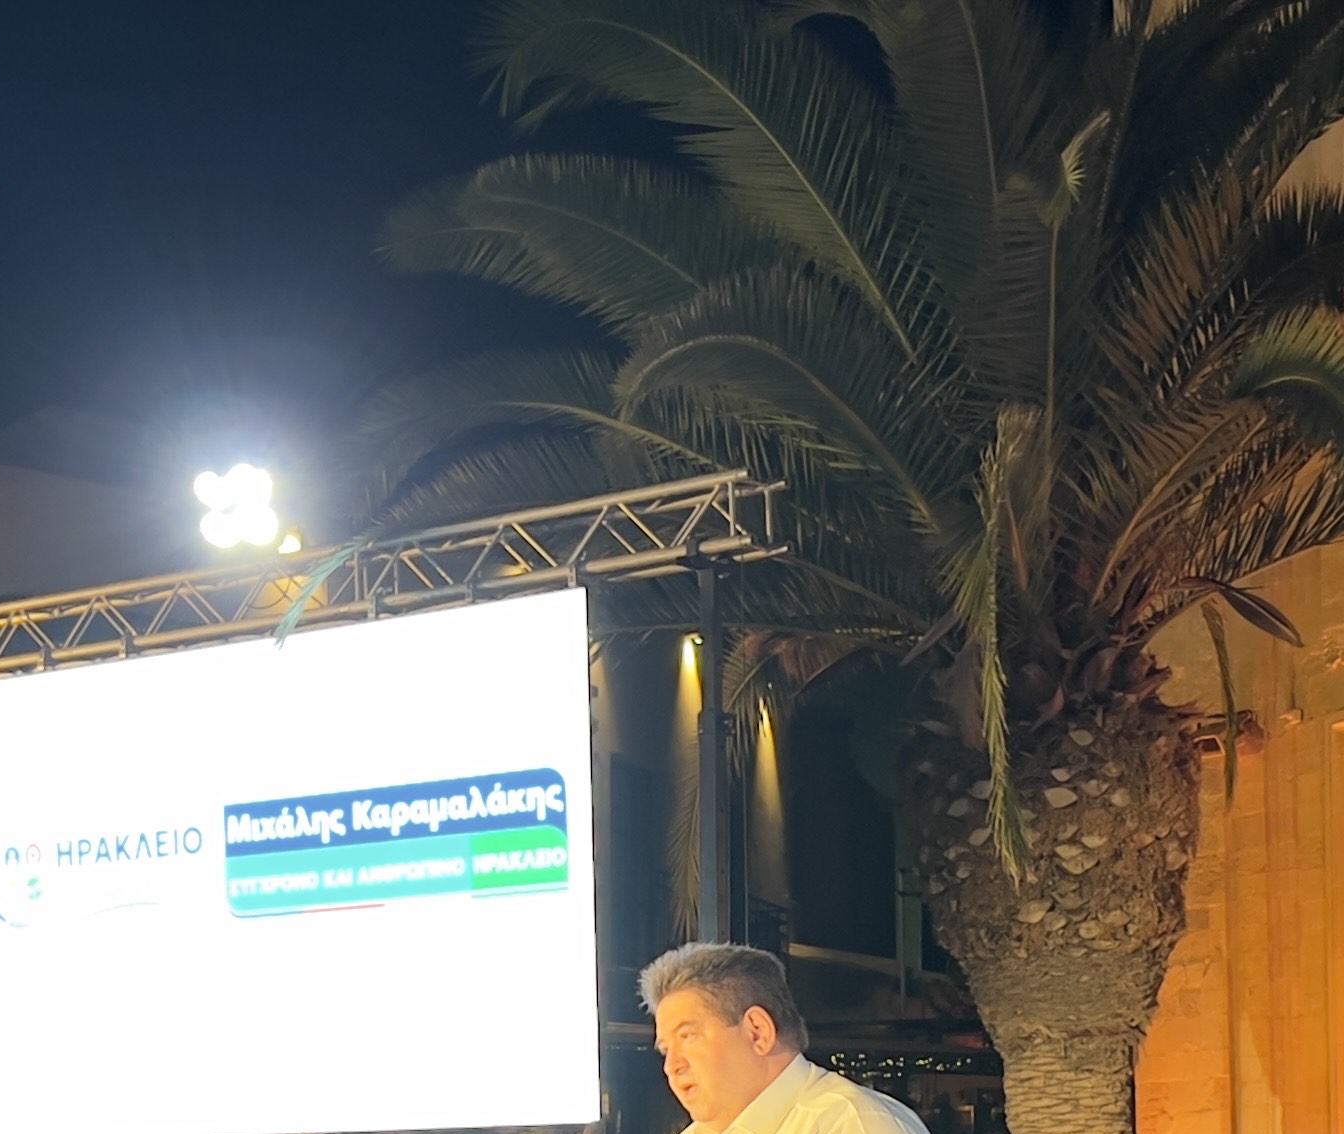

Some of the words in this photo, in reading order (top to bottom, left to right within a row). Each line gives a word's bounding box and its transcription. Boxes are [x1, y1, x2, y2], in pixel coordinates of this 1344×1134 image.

[226, 805, 346, 845] Μιχάλης
[352, 782, 565, 836] Καραμαλάκης
[56, 826, 203, 868] ΗΡΑΚΛΕΙΟ
